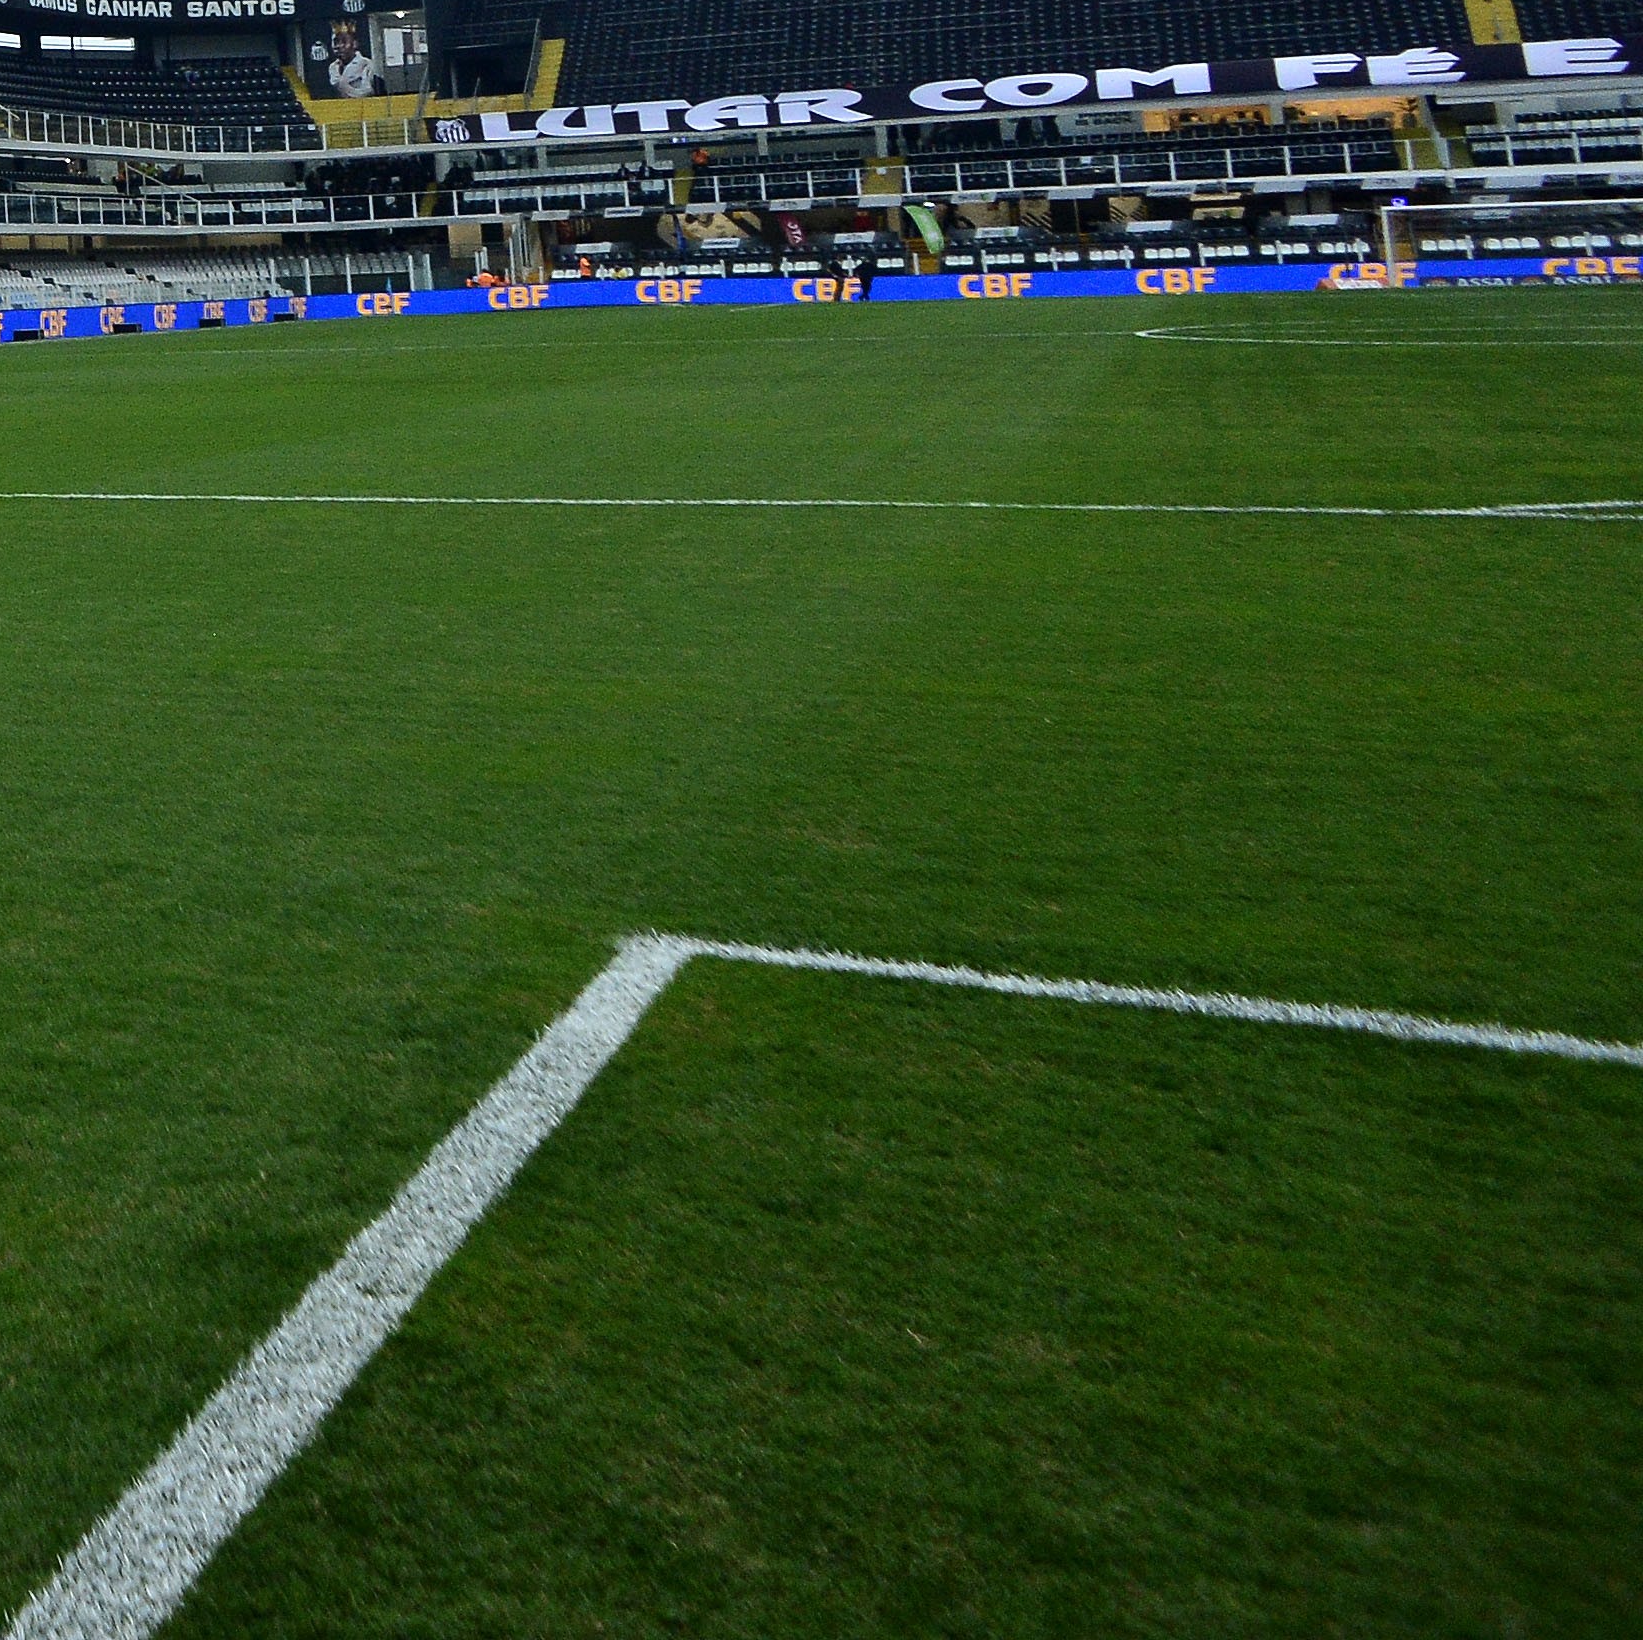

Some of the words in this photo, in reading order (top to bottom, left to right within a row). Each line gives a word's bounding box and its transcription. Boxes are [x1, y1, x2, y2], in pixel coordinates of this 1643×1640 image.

[479, 88, 875, 142] LUTAR
[908, 62, 1212, 112] COM
[1273, 47, 1466, 91] FÉ
[1521, 37, 1630, 76] E
[635, 279, 703, 303] CBF
[792, 278, 862, 302] CBF
[957, 272, 1033, 299] CBF
[1136, 267, 1217, 294] CBF
[356, 292, 411, 316] CBF
[487, 285, 550, 310] CBF
[40, 310, 67, 337] CBF
